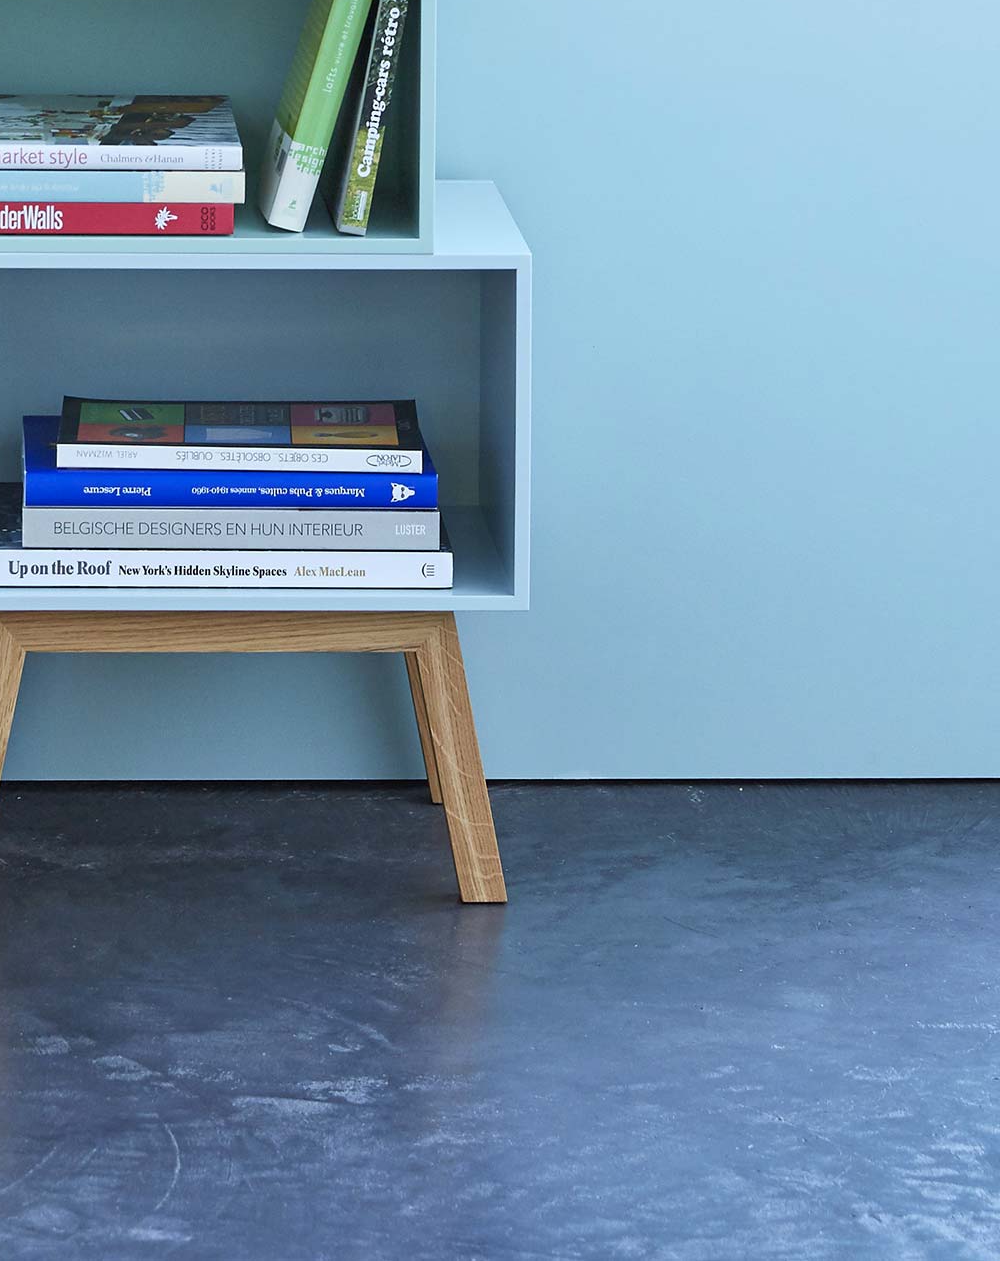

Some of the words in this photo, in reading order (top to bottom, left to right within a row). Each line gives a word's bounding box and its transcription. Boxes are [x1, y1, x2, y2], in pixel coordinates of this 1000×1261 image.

[322, 66, 338, 93] lofts
[357, 60, 391, 177] Camping-cars
[381, 7, 400, 56] rétro
[49, 148, 88, 168] style
[100, 154, 143, 163] Chalmers
[76, 450, 113, 459] WIZMAN
[116, 450, 138, 459] ARIEL
[176, 451, 213, 462] OUBLIÉS
[311, 453, 328, 462] CES
[83, 486, 120, 496] Lescure
[122, 486, 152, 496] Pierre
[229, 486, 256, 495] années
[289, 485, 313, 498] Pubs
[313, 485, 323, 496] &
[324, 485, 366, 498] Marques
[53, 521, 136, 536] BELGISCHE
[138, 521, 222, 536] DESIGNERS
[225, 521, 246, 536] EN
[250, 521, 285, 536] HUN
[288, 521, 363, 537] INTERIEUR
[395, 523, 426, 536] LUSTER
[9, 561, 28, 579] Up
[30, 564, 49, 576] on
[51, 561, 73, 576] the
[77, 560, 111, 576] Roof
[118, 565, 140, 577] New
[174, 565, 211, 577] Hidden
[213, 565, 250, 578] Skyline
[252, 566, 287, 578] Spaces
[294, 567, 317, 577] Alex
[320, 567, 366, 577] MacLean
